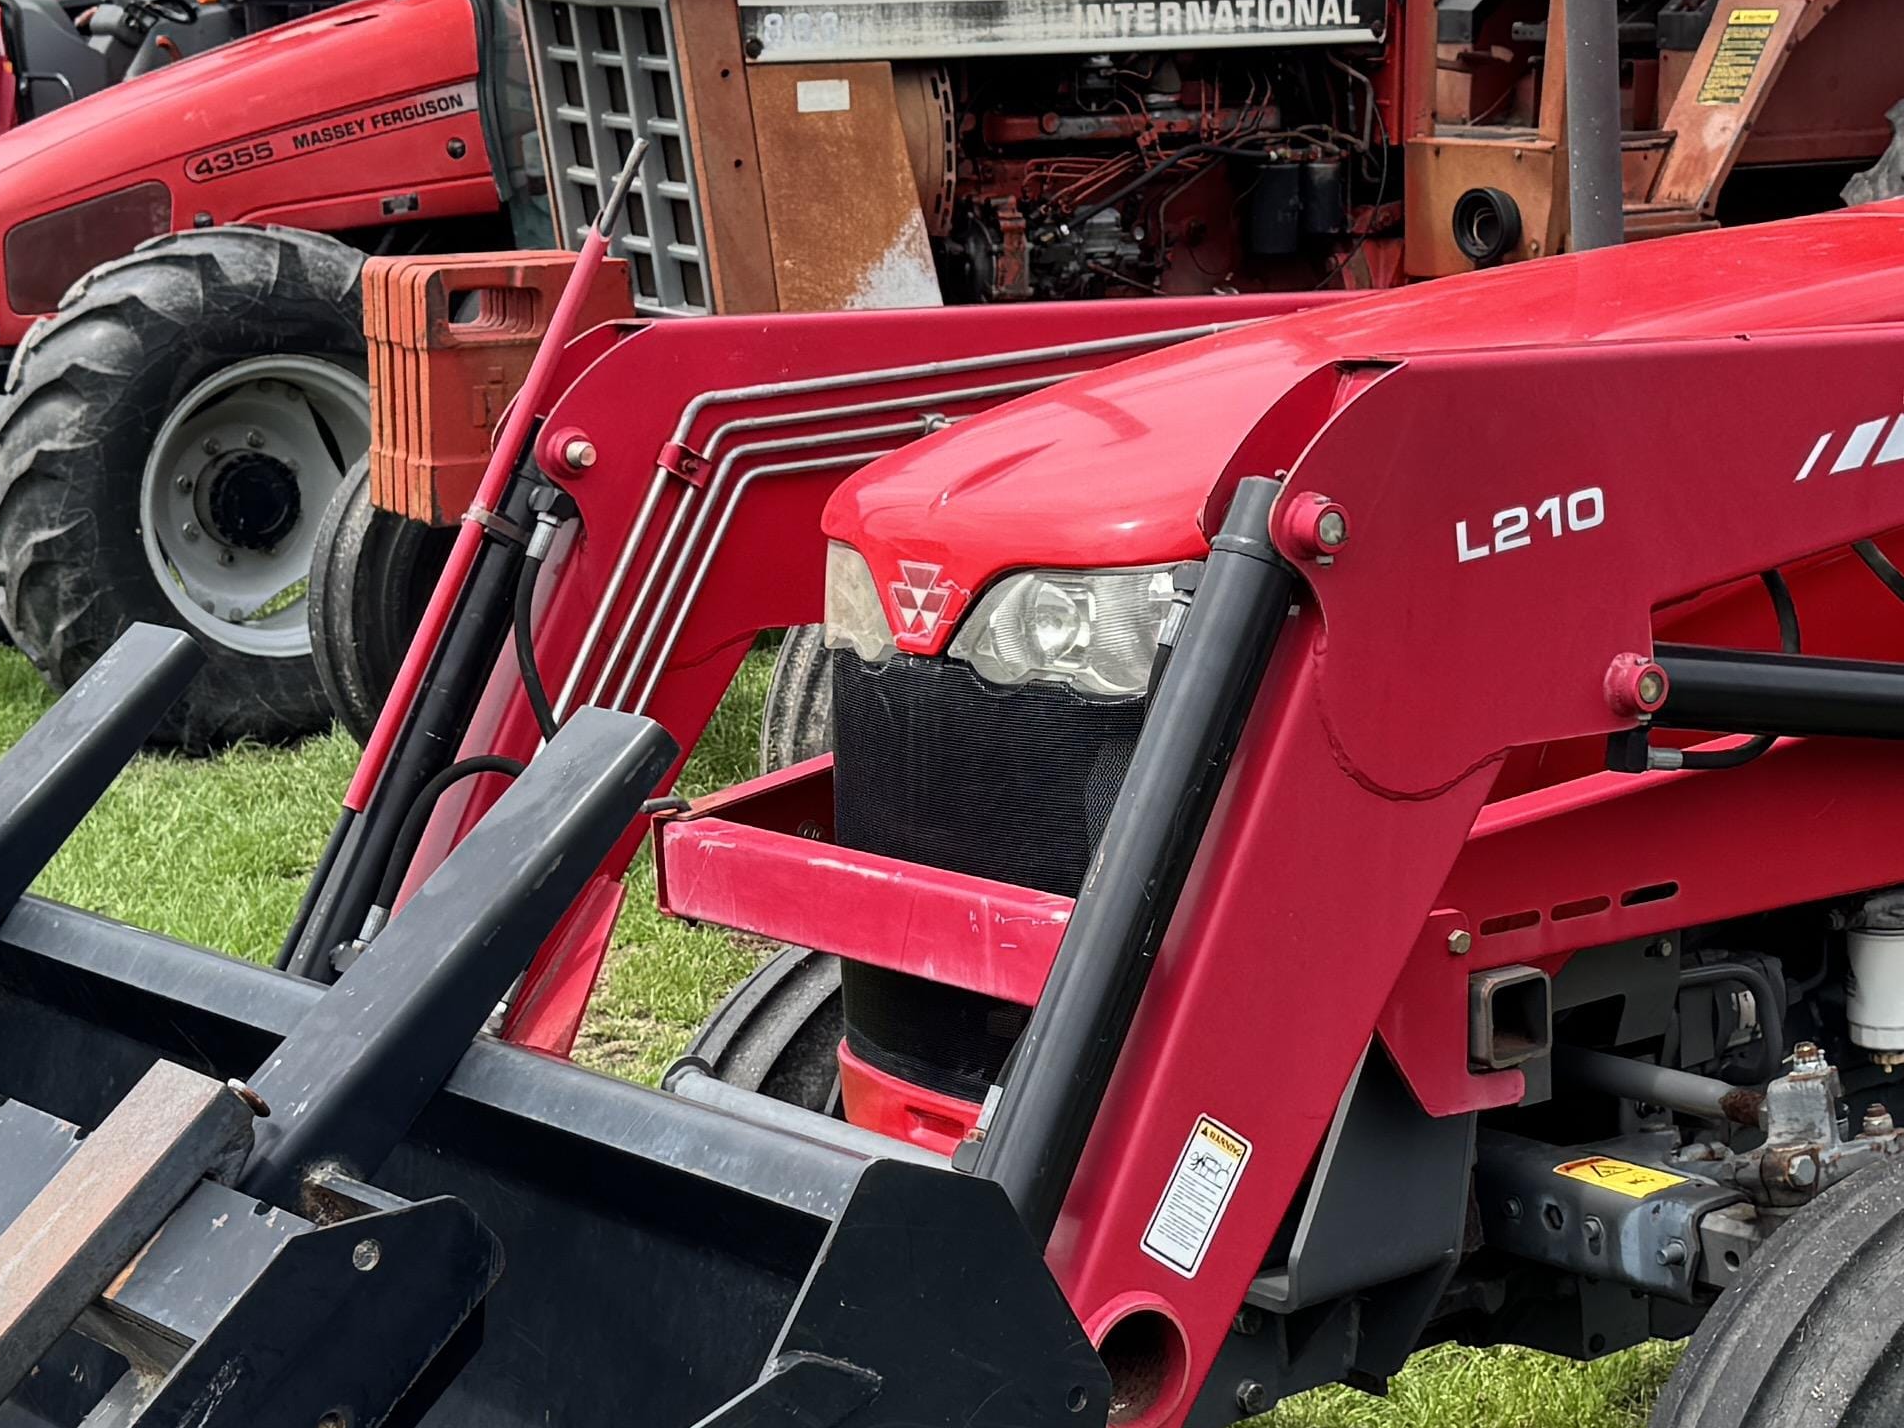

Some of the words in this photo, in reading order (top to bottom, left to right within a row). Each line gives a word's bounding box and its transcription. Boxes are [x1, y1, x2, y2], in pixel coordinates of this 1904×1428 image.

[194, 141, 274, 175] 4355
[292, 118, 366, 150] MASSEY
[371, 93, 463, 129] FERGUSON
[1456, 487, 1605, 562] L210
[1209, 1130, 1242, 1156] WARNING
